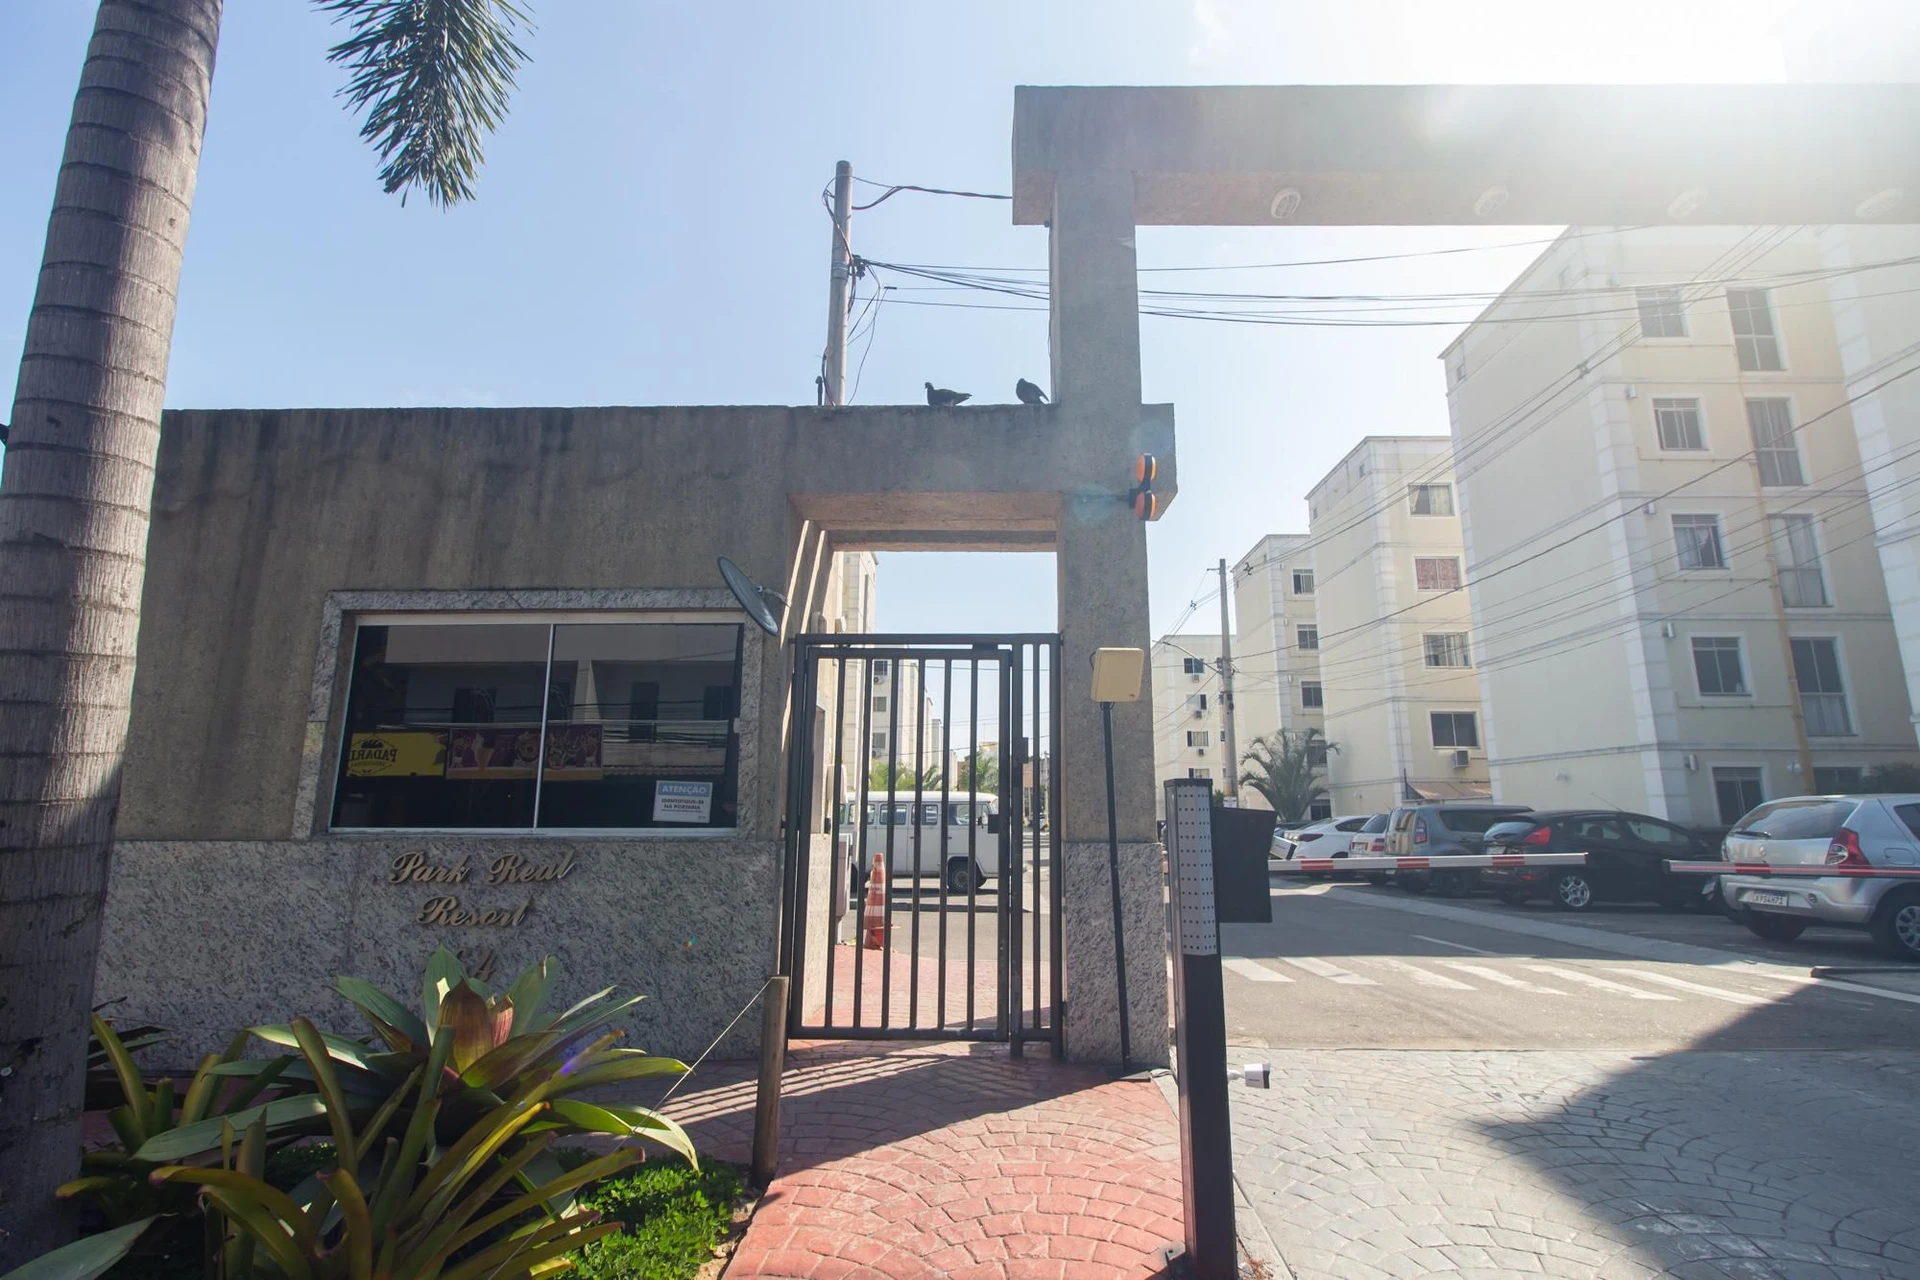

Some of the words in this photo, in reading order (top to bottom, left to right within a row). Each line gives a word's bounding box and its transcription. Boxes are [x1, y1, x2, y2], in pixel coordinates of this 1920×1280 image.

[662, 785, 706, 795] ATENÇÃO
[389, 851, 472, 884] Park
[487, 849, 576, 885] Real
[417, 895, 532, 926] Resort
